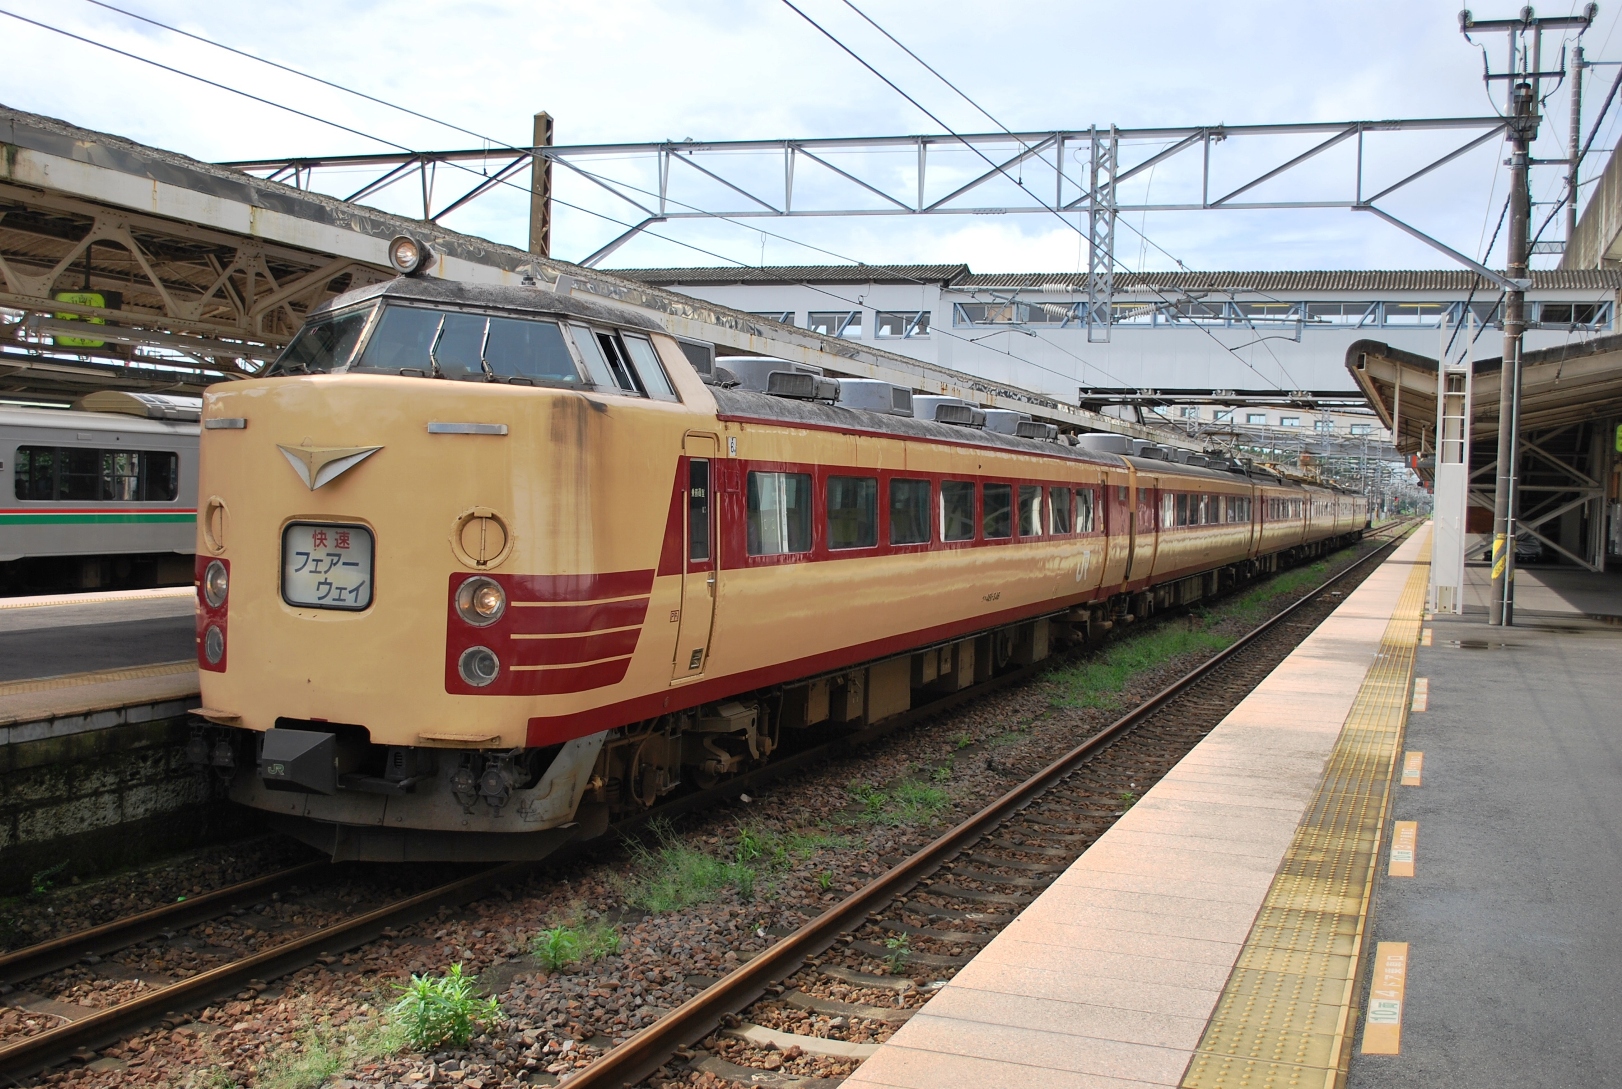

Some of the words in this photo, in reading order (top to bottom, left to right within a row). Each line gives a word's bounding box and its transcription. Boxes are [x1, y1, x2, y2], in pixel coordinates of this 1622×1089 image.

[1407, 455, 1411, 463] 1
[312, 529, 351, 550] 快速
[294, 551, 360, 575] フェアー
[1075, 550, 1091, 583] JR
[316, 577, 366, 603] ウェイ
[267, 763, 285, 775] JR
